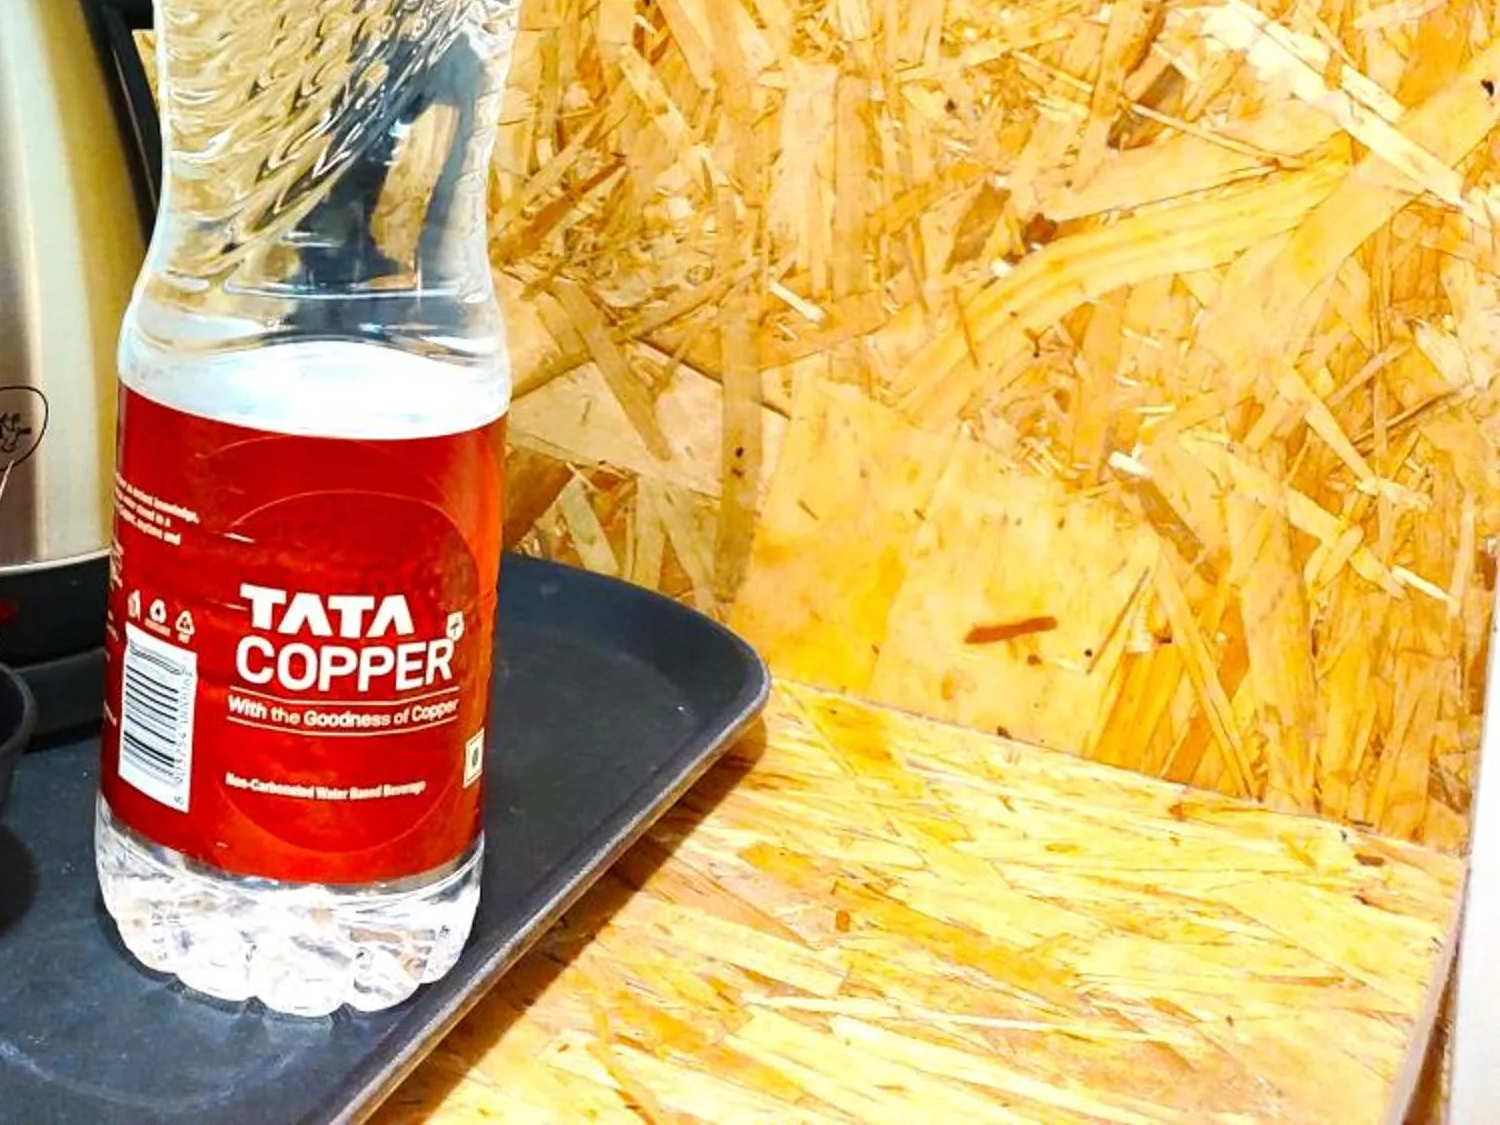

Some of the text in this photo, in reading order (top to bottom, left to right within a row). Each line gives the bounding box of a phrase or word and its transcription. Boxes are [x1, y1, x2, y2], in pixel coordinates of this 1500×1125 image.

[239, 582, 415, 639] TATA
[236, 635, 455, 693] COPPER
[228, 695, 460, 728] With the Goodness of Copper
